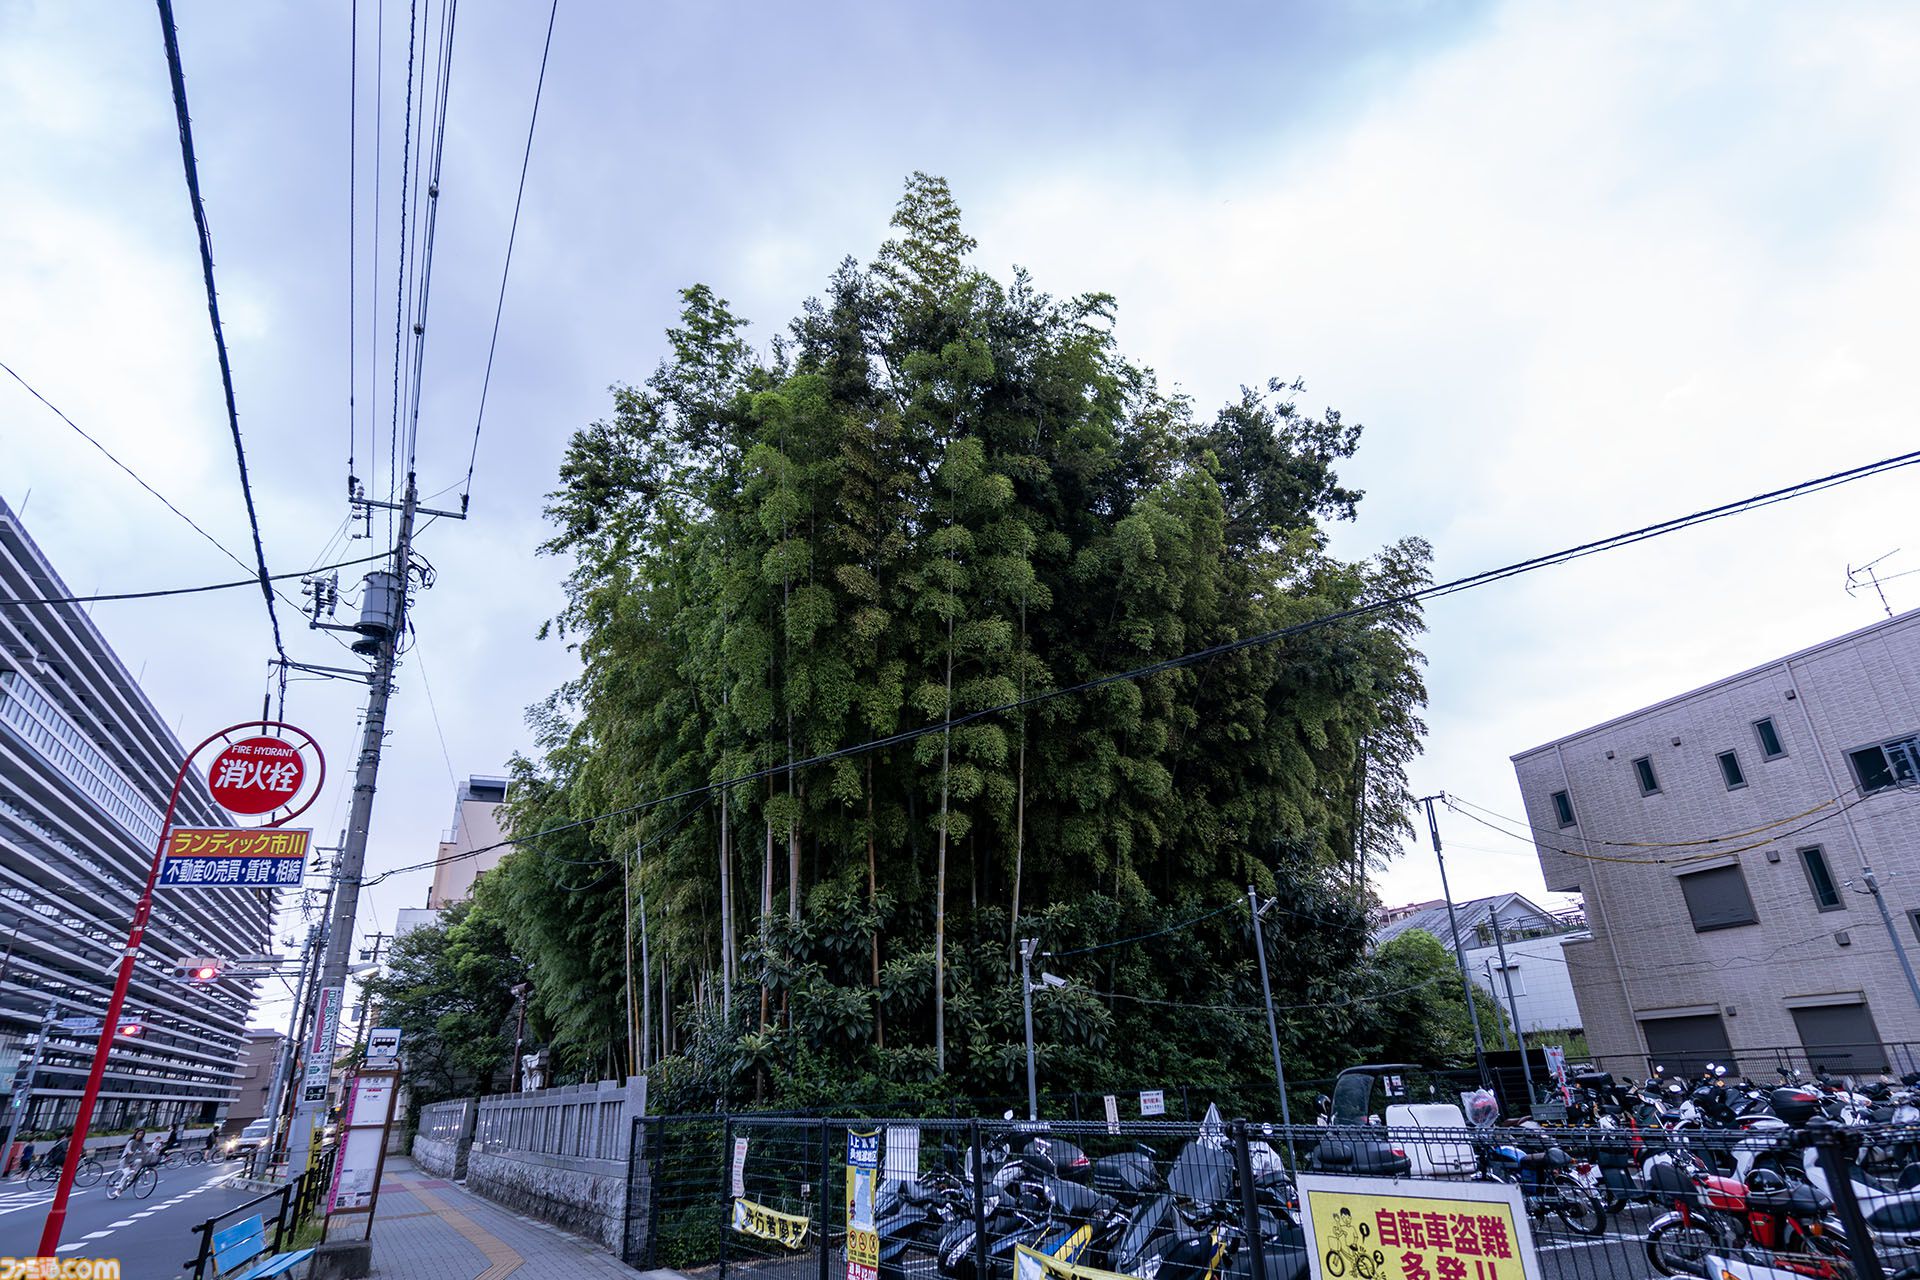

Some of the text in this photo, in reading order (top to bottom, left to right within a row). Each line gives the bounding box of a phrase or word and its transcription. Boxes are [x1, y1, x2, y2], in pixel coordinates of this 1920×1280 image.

[231, 745, 295, 757] FIRE HYDRANT
[215, 758, 299, 792] 消火栓
[175, 832, 306, 855] ランディック市川
[166, 858, 301, 883] 不動産の売買・賃貸・相続
[320, 989, 337, 1053] 日下部クリニック
[1375, 1208, 1513, 1260] 自転車盗難
